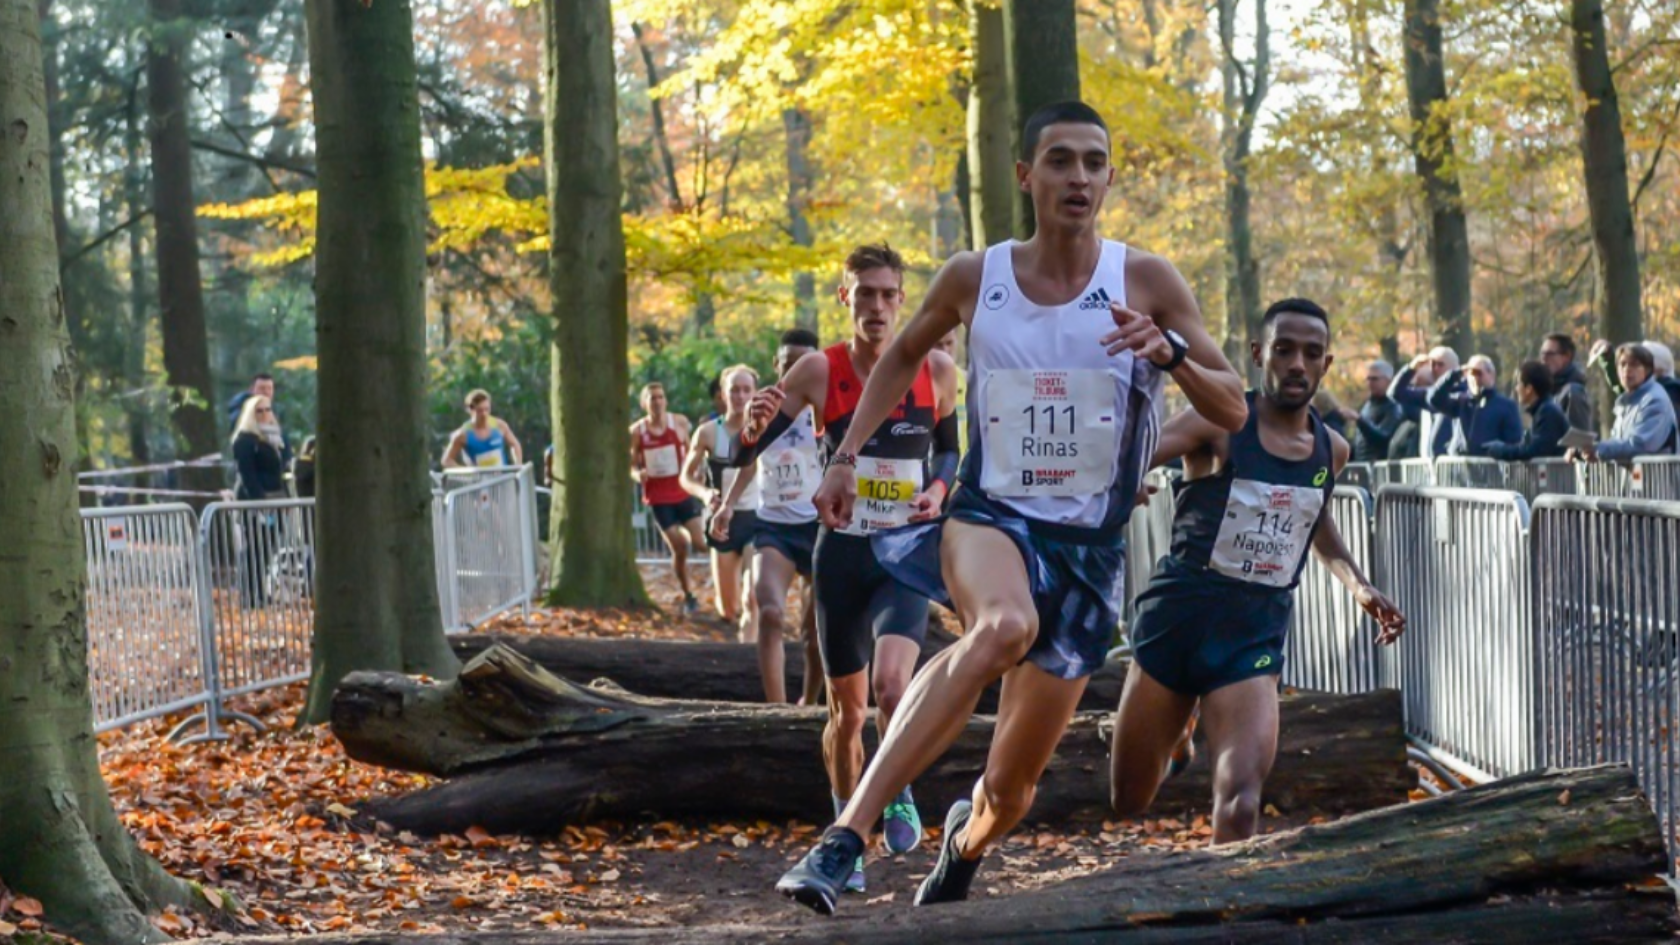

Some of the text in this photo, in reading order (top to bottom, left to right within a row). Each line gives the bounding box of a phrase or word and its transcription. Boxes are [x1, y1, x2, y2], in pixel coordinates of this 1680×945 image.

[1079, 301, 1112, 311] adida
[1022, 405, 1075, 435] 111
[1022, 437, 1078, 457] Rinas
[776, 464, 800, 478] 171
[1022, 469, 1076, 486] B BRABANT
[867, 480, 900, 501] 105
[1035, 478, 1064, 486] SPORT
[867, 501, 896, 514] Mike
[1257, 512, 1293, 537] 114
